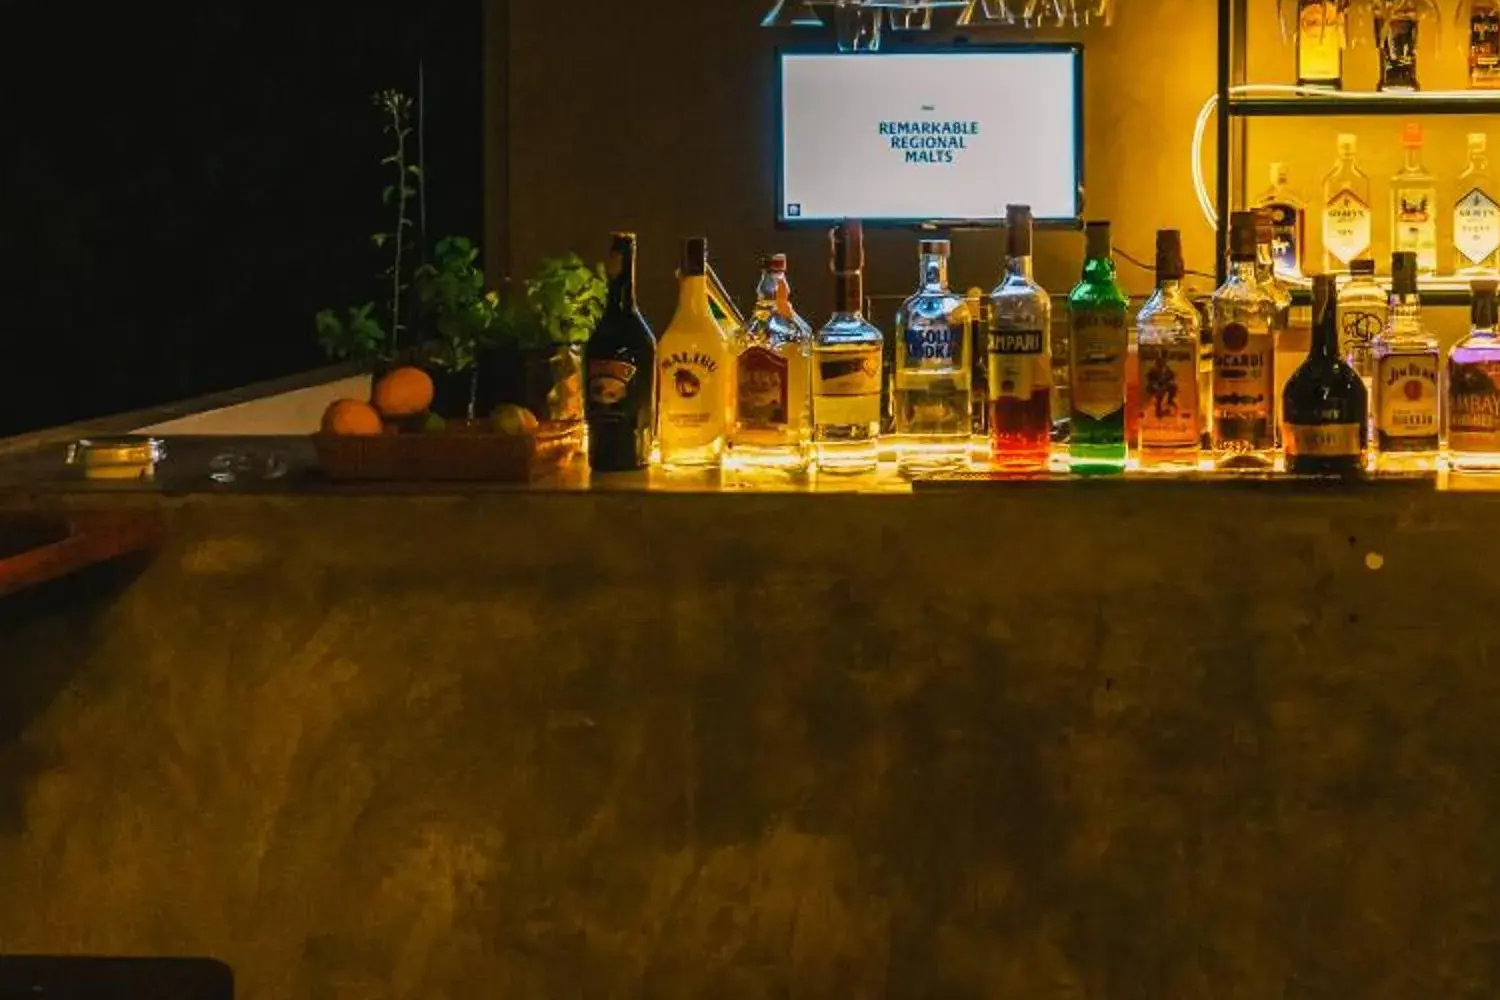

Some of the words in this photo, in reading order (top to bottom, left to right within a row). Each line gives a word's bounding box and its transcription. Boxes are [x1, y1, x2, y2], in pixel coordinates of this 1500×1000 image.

[878, 121, 978, 134] REMARKABLE
[891, 136, 966, 149] REGIONAL
[904, 150, 953, 163] MALTS
[988, 333, 1040, 351] AMPARI
